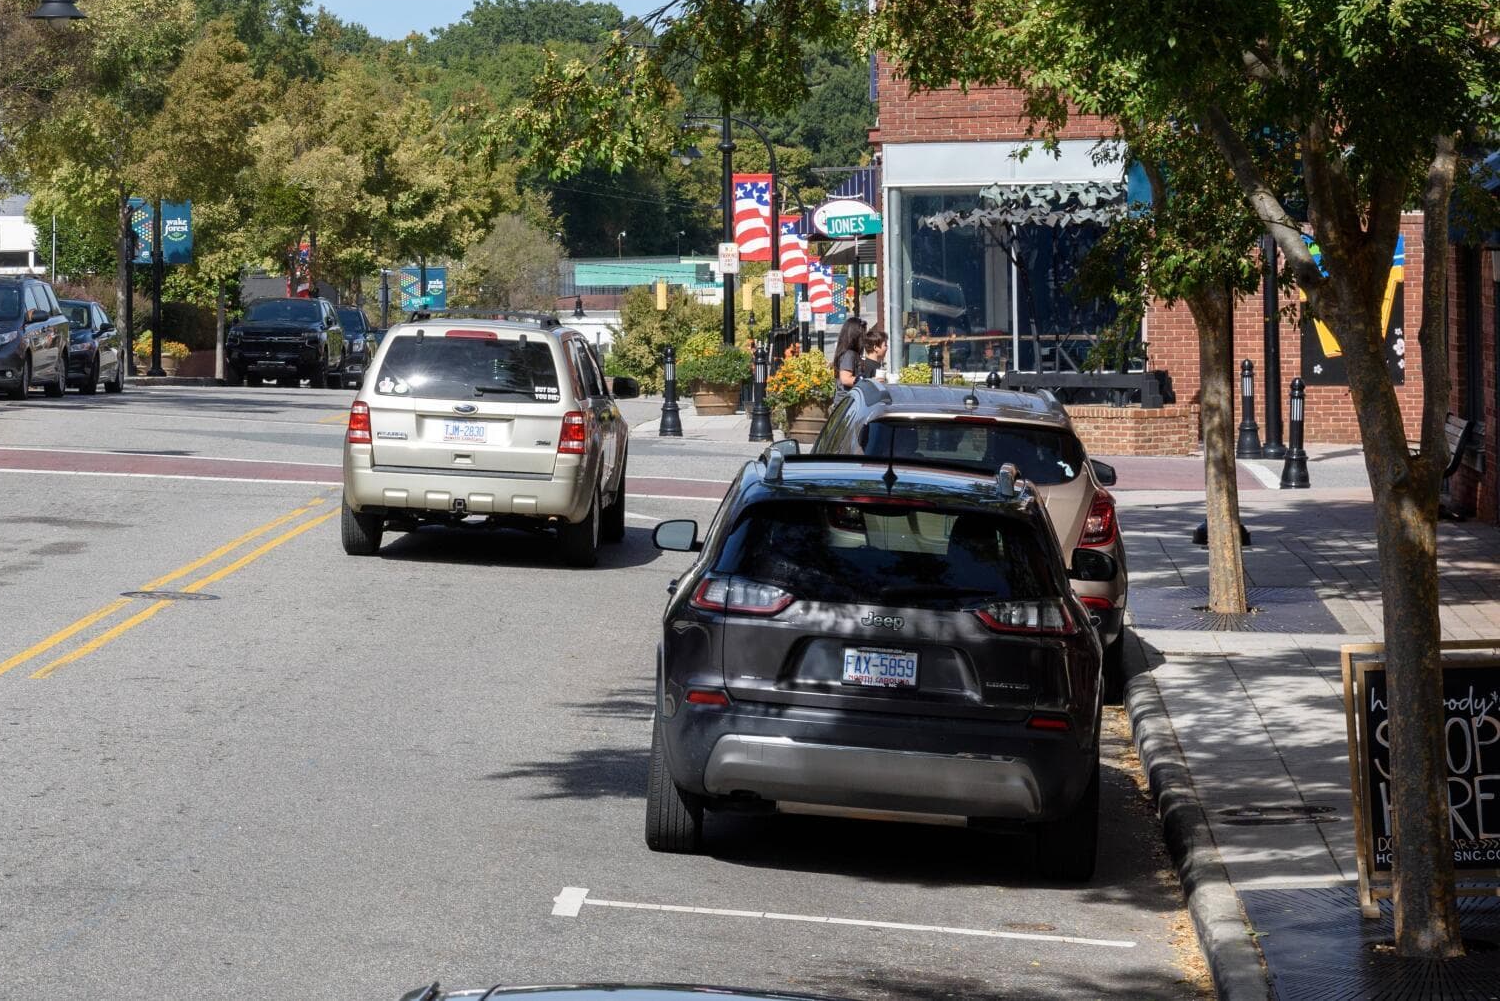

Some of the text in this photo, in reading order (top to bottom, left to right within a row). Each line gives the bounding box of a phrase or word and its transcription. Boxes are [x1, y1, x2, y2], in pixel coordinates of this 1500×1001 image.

[828, 217, 865, 235] JONES
[861, 611, 904, 630] Jeep
[845, 655, 914, 678] FAX-5859
